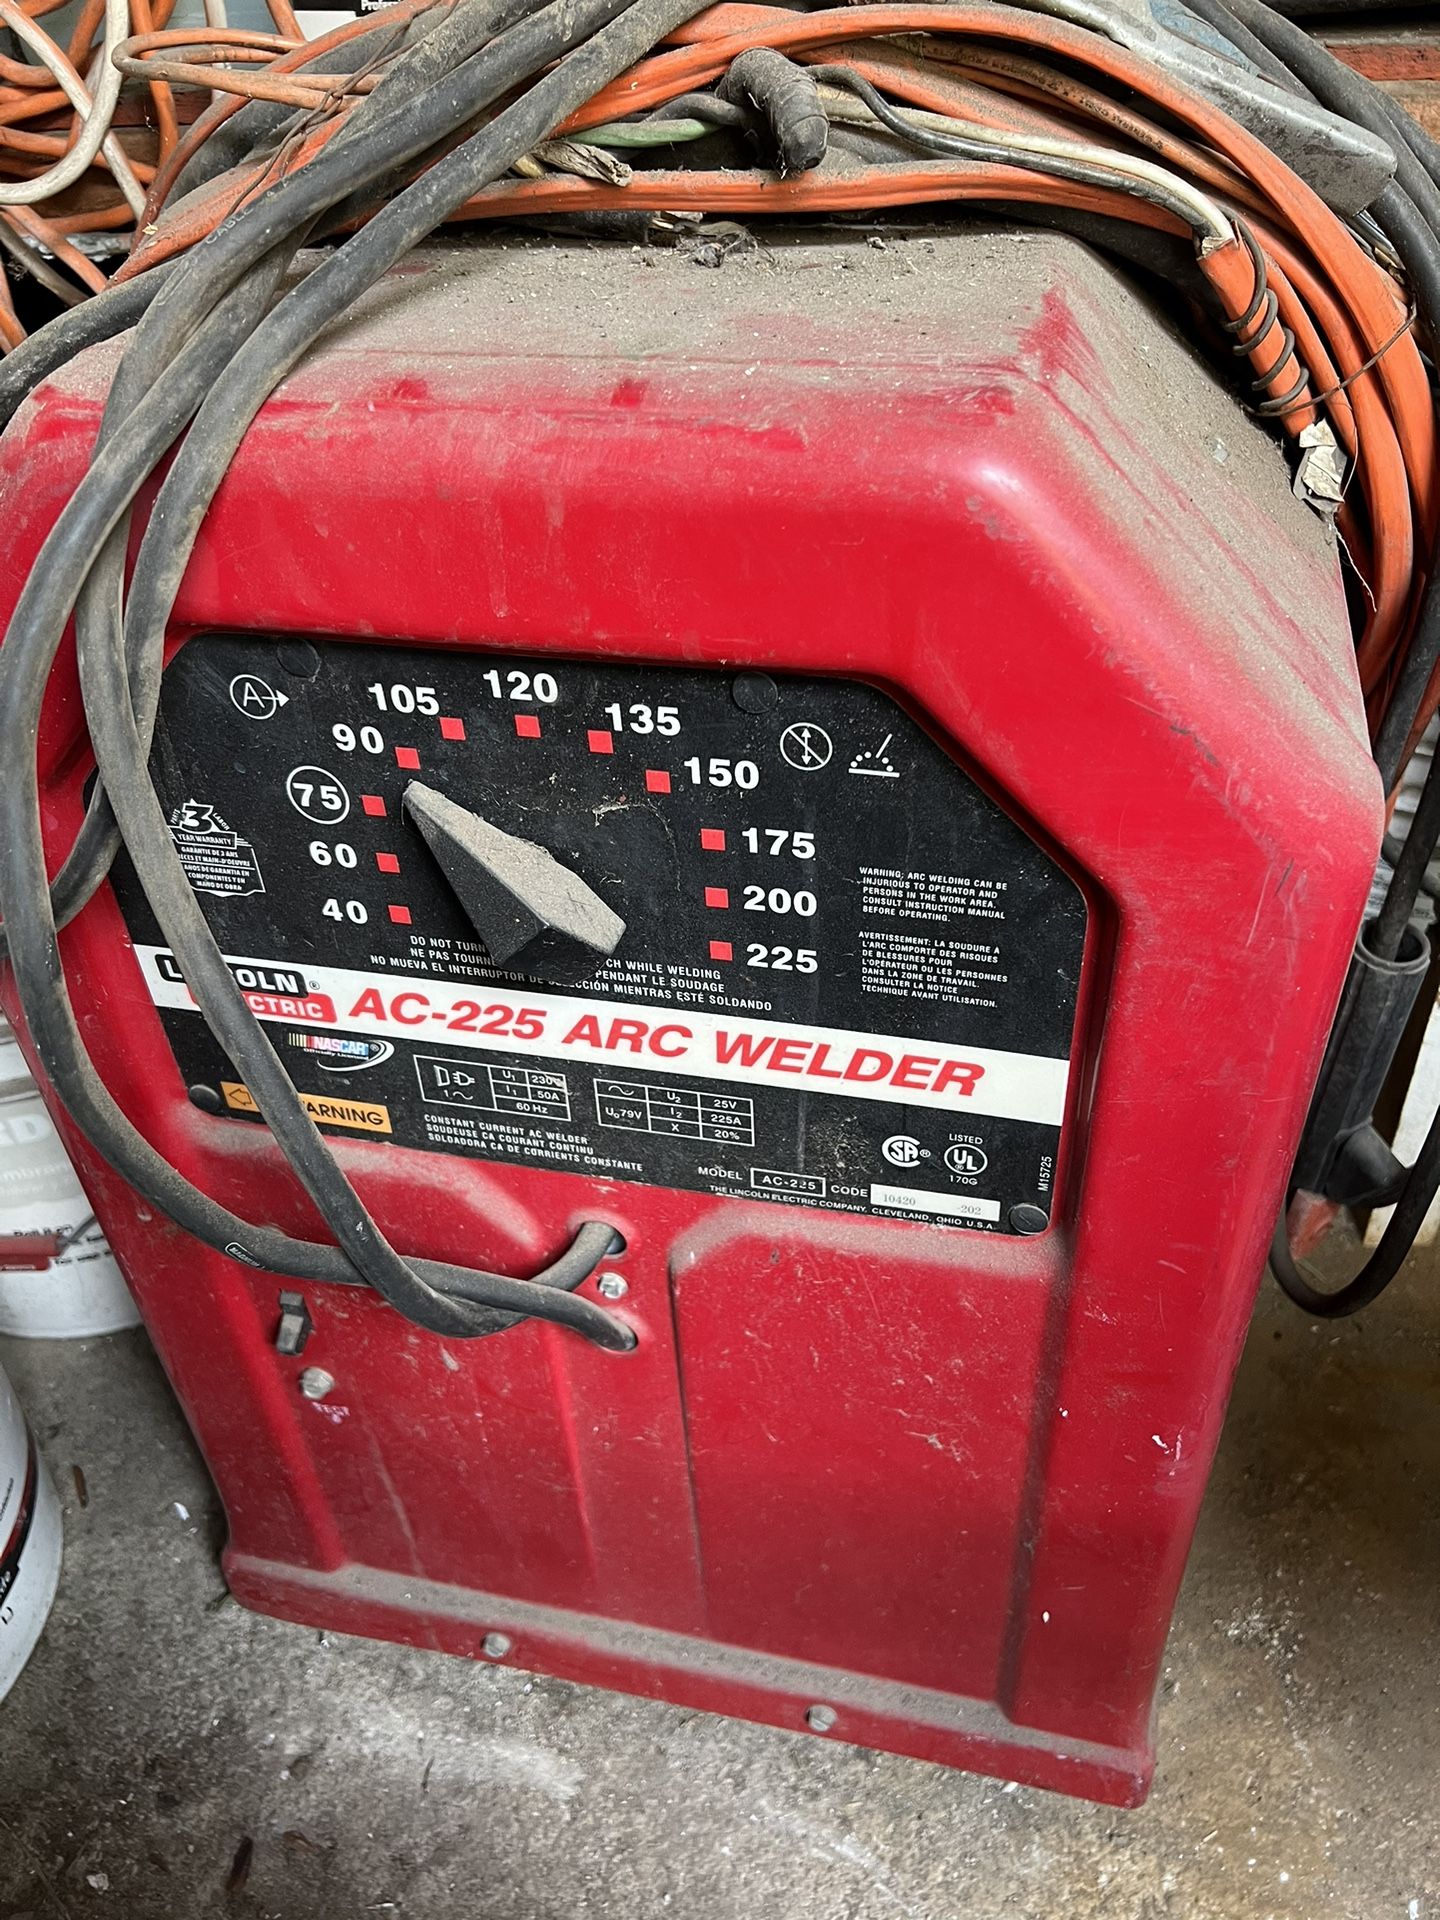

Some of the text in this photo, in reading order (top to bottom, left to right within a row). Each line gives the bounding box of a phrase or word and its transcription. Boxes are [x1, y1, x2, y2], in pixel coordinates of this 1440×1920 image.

[483, 670, 559, 703] 120
[368, 683, 440, 716] 105
[604, 703, 681, 736] 135
[332, 723, 385, 755] 90
[684, 757, 760, 790] 150
[292, 783, 343, 811] 75
[212, 812, 230, 831] LABOR
[178, 833, 232, 845] YEAR WARRANTY
[741, 828, 816, 859] 175
[181, 847, 211, 856] GARANTIE
[309, 841, 358, 869] 60
[188, 872, 232, 882] COMPONENTES
[196, 880, 215, 888] MANO
[241, 869, 250, 877] EN
[907, 872, 926, 881] ARC
[929, 874, 970, 886] WELDING
[974, 880, 992, 888] CAN
[996, 883, 1008, 891] BE
[862, 877, 998, 899] INJURIOUS TO OPERATOR AND
[862, 886, 997, 909] PERSONS IN THE WORK AREA.
[322, 898, 368, 924] 40
[742, 886, 818, 917] 200
[862, 896, 1006, 920] CONSULT INSTRUCTION MANUAL
[862, 905, 951, 922] BEFORE OPERATING.
[410, 935, 486, 953] DO NOT TURN
[858, 930, 931, 946] AVERTISSEMENT:
[934, 940, 946, 948] LA
[949, 941, 991, 953] SOUDURE
[862, 940, 998, 964] L'ARC COMPORTE DES RISQUES
[410, 948, 424, 957] NE
[429, 950, 449, 960] PAS
[746, 944, 818, 974] 225
[862, 949, 953, 967] DE BLESSURES POUR
[164, 960, 299, 994] LOLN
[595, 970, 725, 993] PENDANT LE SOUDAGE
[625, 960, 663, 973] WHILE
[667, 965, 721, 980] WELDING
[862, 967, 980, 988] DANS LA ZONE DE TRAVAIL.
[921, 965, 934, 973] OU
[936, 967, 953, 976] LES
[955, 969, 1008, 983] PERSONNES
[370, 955, 385, 965] NO
[390, 957, 428, 970] MUEVA
[432, 963, 445, 973] EL
[449, 965, 525, 982] INTERRUPTOR
[614, 984, 672, 999] MIENTRAS
[676, 991, 705, 1003] ESTÉ
[709, 995, 772, 1011] SOLDANDO
[862, 975, 958, 994] CONSULTER LA NOTICE
[243, 994, 324, 1018] CTRIC
[862, 984, 998, 1008] TECHNIQUE AVANT UTILISATION.
[348, 988, 986, 1098] AC-225 ARC WELDER
[537, 1090, 560, 1101] 50A
[713, 1099, 737, 1109] 25V
[301, 1100, 384, 1126] ARNING
[516, 1102, 548, 1114] 60 Hz
[711, 1113, 742, 1126] 225A
[424, 1114, 588, 1144] CONSTANT CURRENT AC WELDER
[427, 1123, 594, 1155] SOUDEUSE CA COURANT CONTINU
[671, 1123, 740, 1140] X 20%
[949, 1133, 983, 1145] LISTED
[428, 1133, 487, 1148] SOLDADORA
[490, 1141, 503, 1151] CA
[507, 1144, 521, 1153] DE
[584, 1156, 643, 1171] CONSTANTE
[953, 1149, 978, 1171] UL
[949, 1175, 978, 1186] 170G
[1037, 1156, 1052, 1192] M15725
[698, 1167, 743, 1180] MODEL
[762, 1175, 816, 1190] AC-225
[830, 1185, 869, 1197] CODE
[883, 1193, 916, 1206] 10420
[710, 1185, 728, 1193] THE
[729, 1188, 770, 1200] LINCOLN
[772, 1194, 817, 1206] ELECTRIC
[936, 1215, 962, 1226] OHIO
